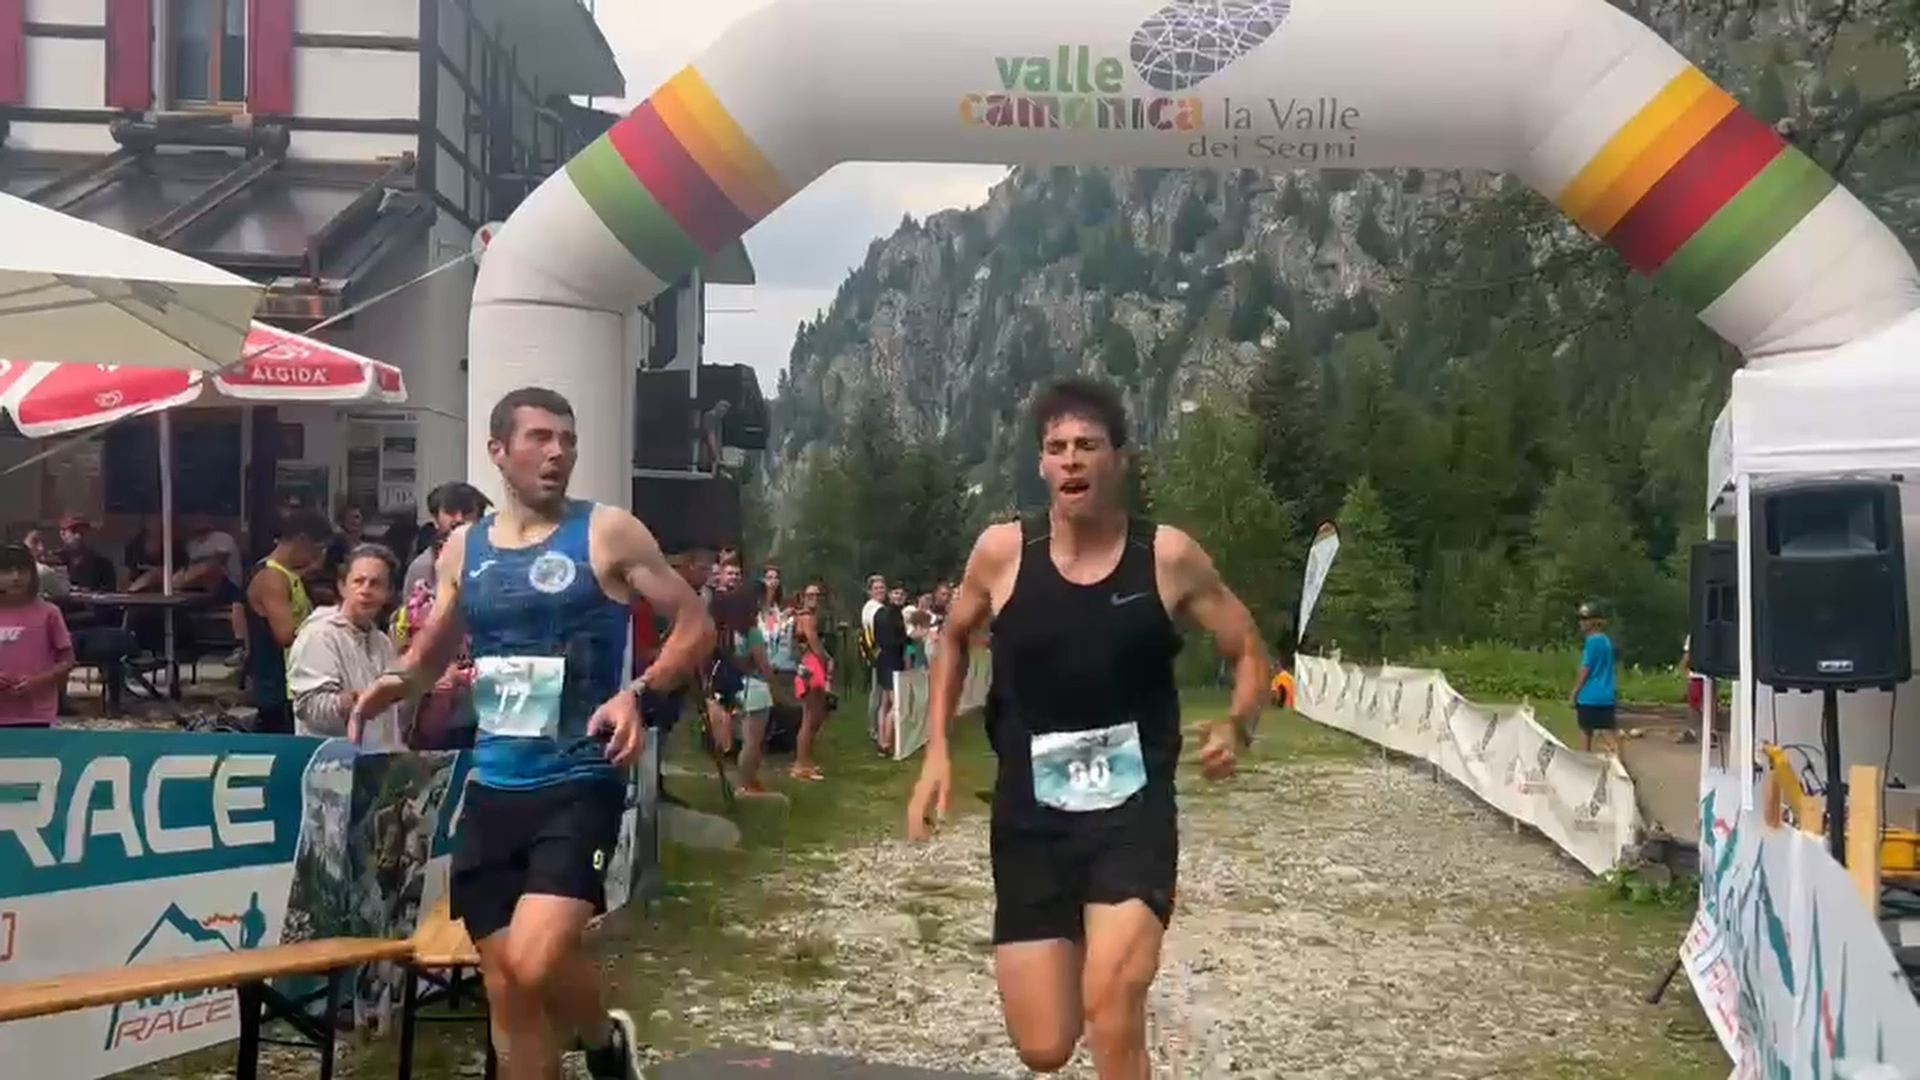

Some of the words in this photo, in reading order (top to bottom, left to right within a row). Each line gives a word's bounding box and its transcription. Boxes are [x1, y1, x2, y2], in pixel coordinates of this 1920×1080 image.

[994, 45, 1124, 93] valle
[959, 94, 1203, 131] camonica
[1222, 98, 1252, 130] la
[1272, 98, 1360, 130] Valle
[1187, 136, 1239, 160] dei
[1254, 136, 1357, 162] Segni
[252, 366, 328, 382] ALGIDA
[0, 754, 275, 867] RACE
[114, 995, 234, 1048] RACE
